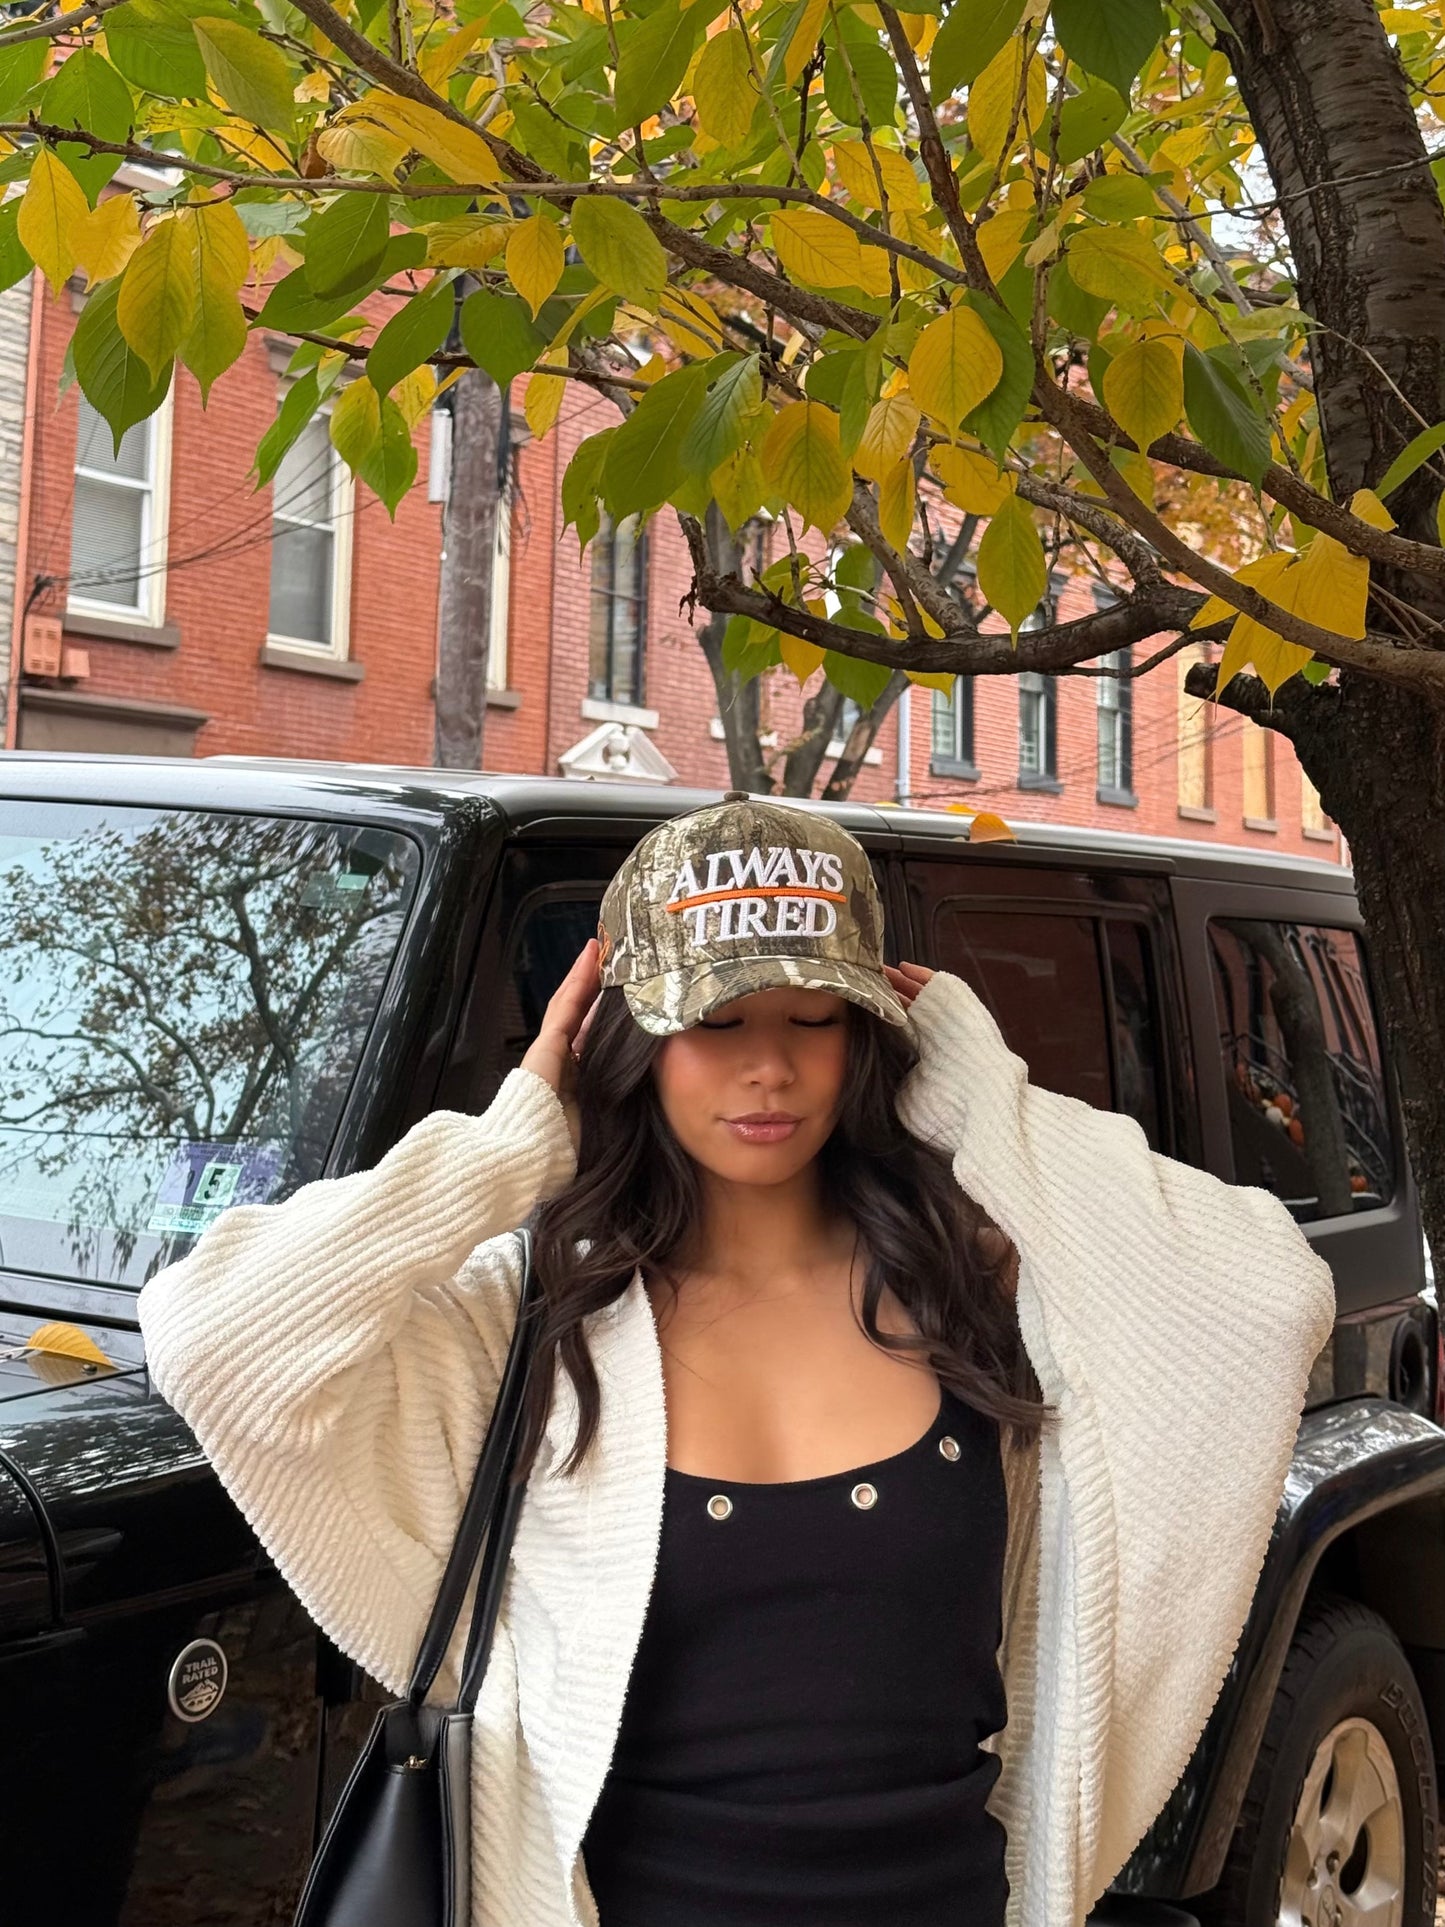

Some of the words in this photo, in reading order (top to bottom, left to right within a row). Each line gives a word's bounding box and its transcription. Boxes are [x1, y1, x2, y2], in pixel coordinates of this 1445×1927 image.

[667, 846, 844, 905] ALWAYS
[682, 896, 837, 947] TIRED
[182, 1666, 219, 1685] RATED
[184, 1656, 217, 1673] TRAIL
